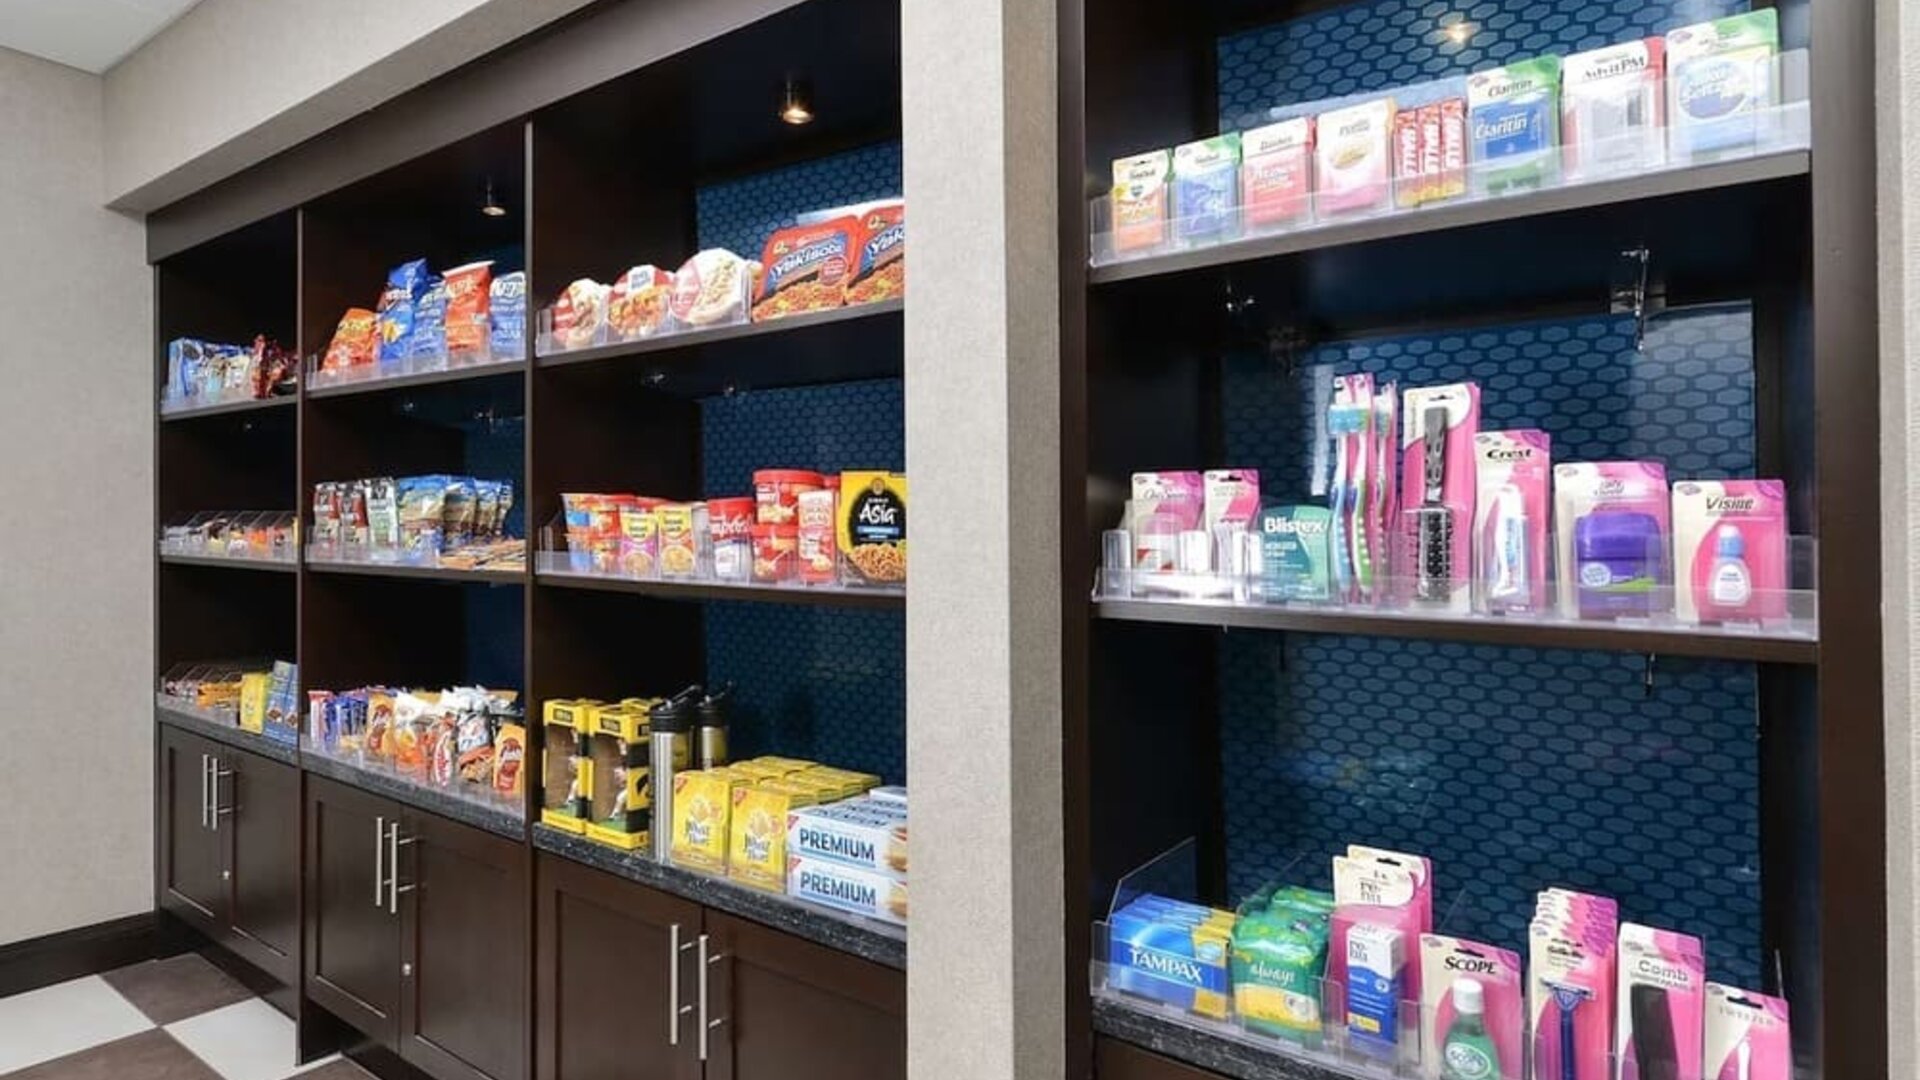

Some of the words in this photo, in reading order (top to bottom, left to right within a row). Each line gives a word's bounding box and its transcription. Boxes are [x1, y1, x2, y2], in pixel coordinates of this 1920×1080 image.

[1487, 80, 1533, 98] Claritin
[1475, 113, 1528, 140] Claritin
[772, 239, 843, 275] Yakisoba
[1486, 448, 1531, 460] Crest
[859, 501, 900, 525] Asia
[1705, 496, 1754, 511] Visine
[1264, 516, 1324, 535] Blistex
[799, 827, 876, 862] PREMIUM
[800, 871, 877, 907] PREMIUM
[1128, 947, 1203, 983] TAMPAX
[1250, 960, 1296, 985] always
[1443, 955, 1498, 975] SCOPE
[1638, 959, 1689, 982] Comb
